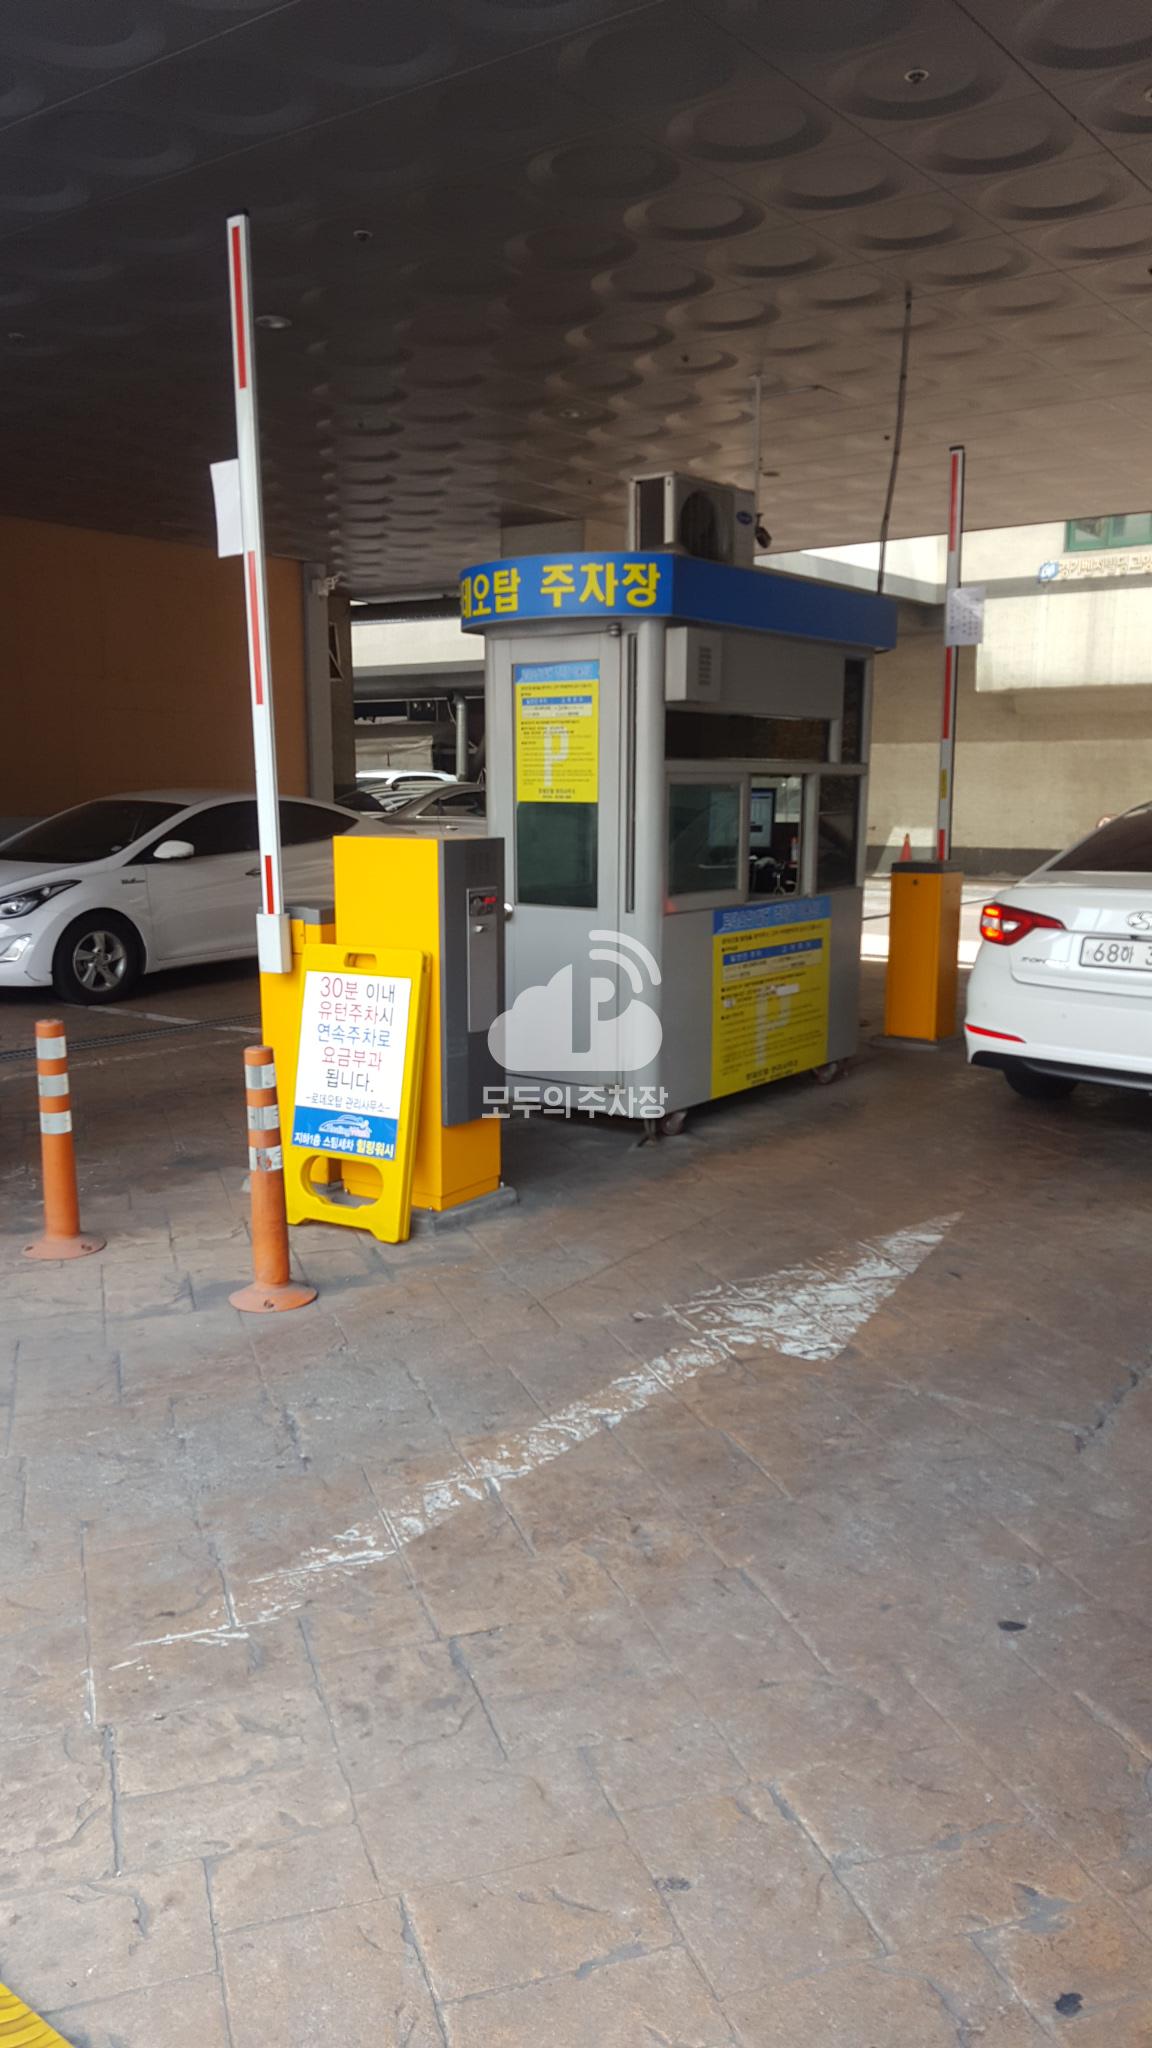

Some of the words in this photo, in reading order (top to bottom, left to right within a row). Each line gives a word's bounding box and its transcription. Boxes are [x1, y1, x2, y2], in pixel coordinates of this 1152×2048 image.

[540, 562, 661, 608] 주차장
[1093, 943, 1134, 964] 68하
[320, 976, 358, 1000] 30분
[366, 983, 395, 1003] 이내
[318, 1001, 393, 1026] 유턴주차시
[317, 1023, 390, 1047] 연속주차로
[322, 1046, 382, 1071] 요금부과
[325, 1068, 374, 1093] 됩니다.
